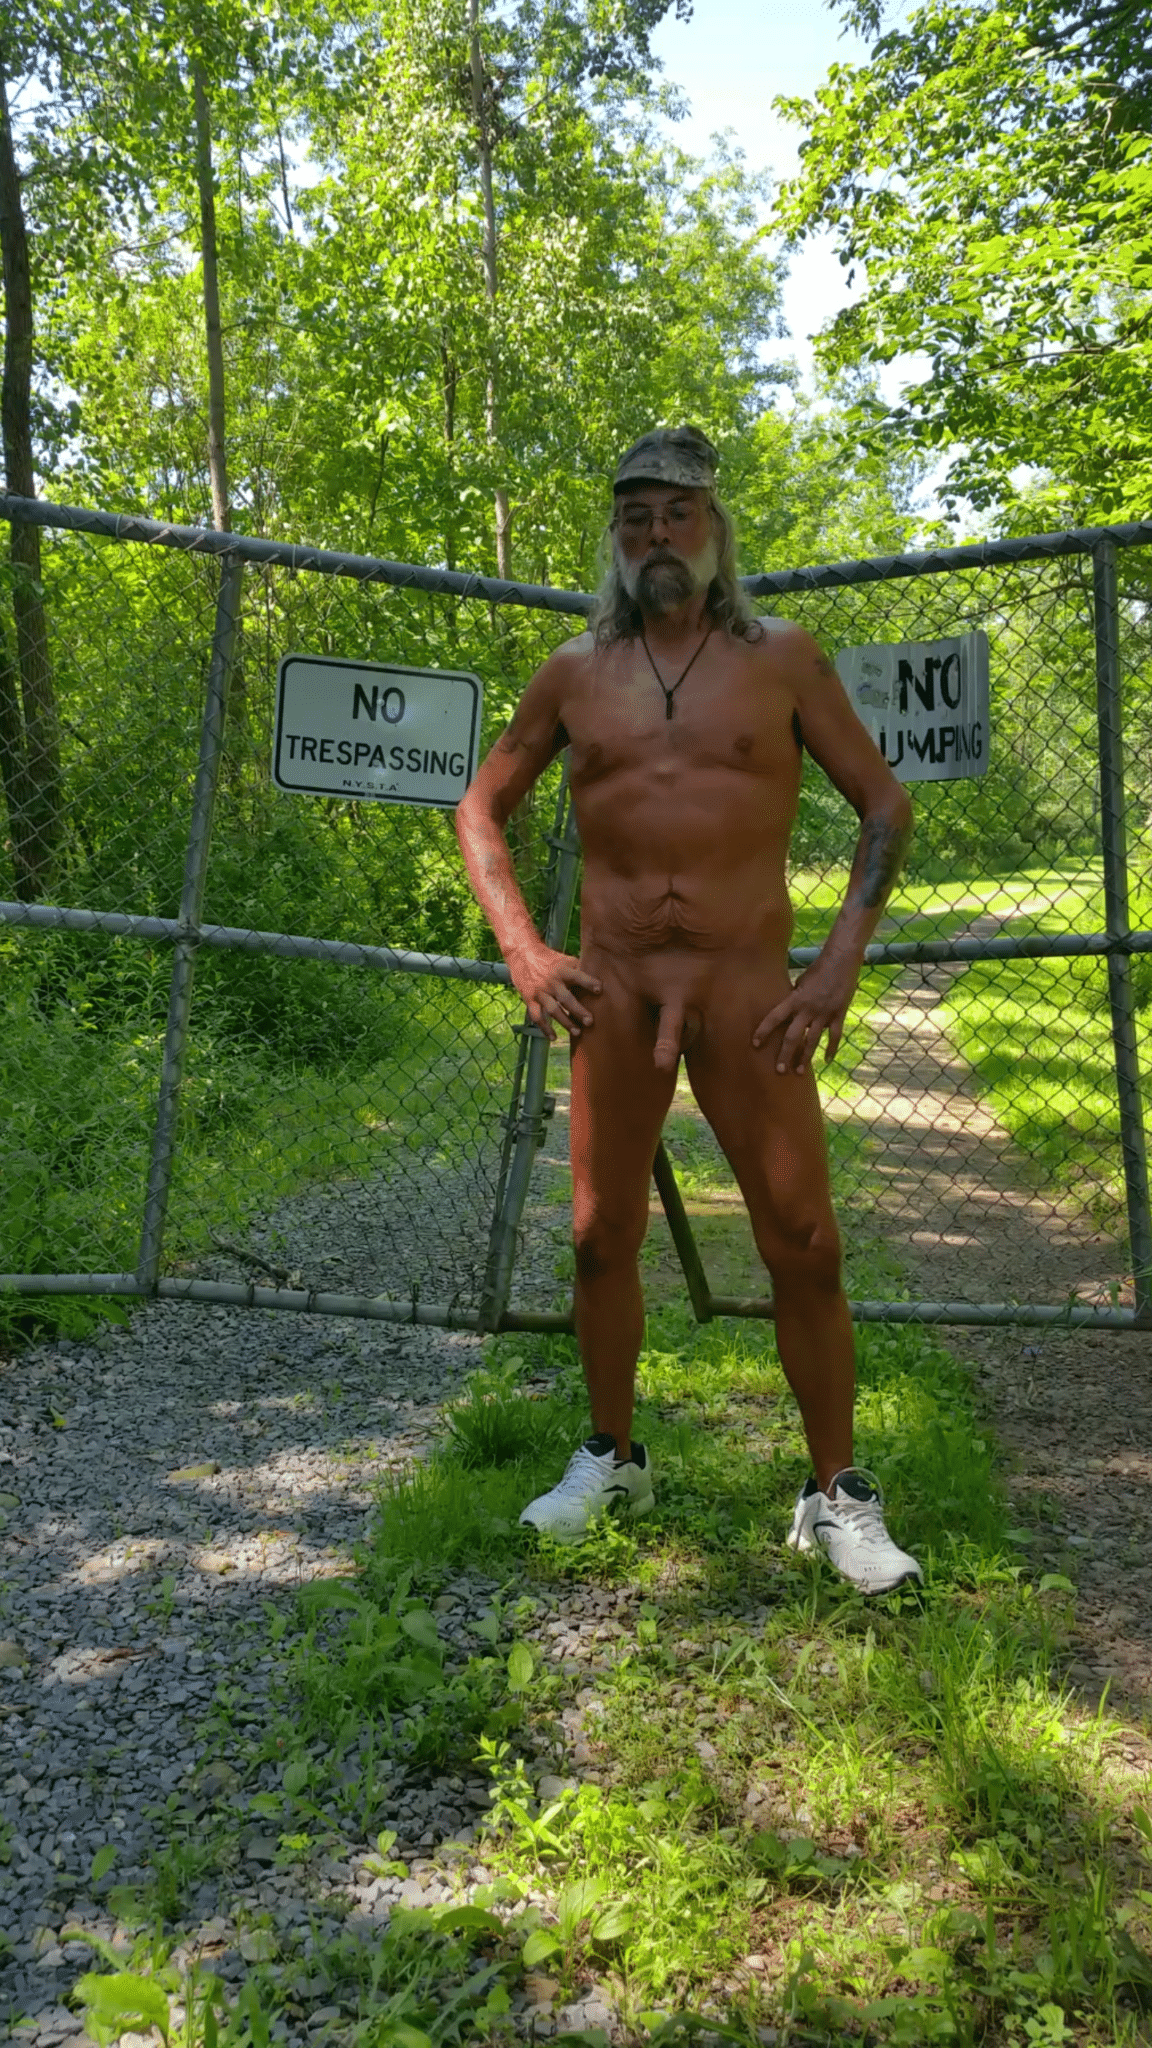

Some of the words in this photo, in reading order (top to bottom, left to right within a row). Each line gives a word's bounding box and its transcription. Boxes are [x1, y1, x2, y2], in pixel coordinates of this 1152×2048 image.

[352, 683, 405, 724] NO
[898, 653, 962, 714] NO
[286, 734, 465, 777] TRESPASSING
[880, 720, 982, 768] UMPING
